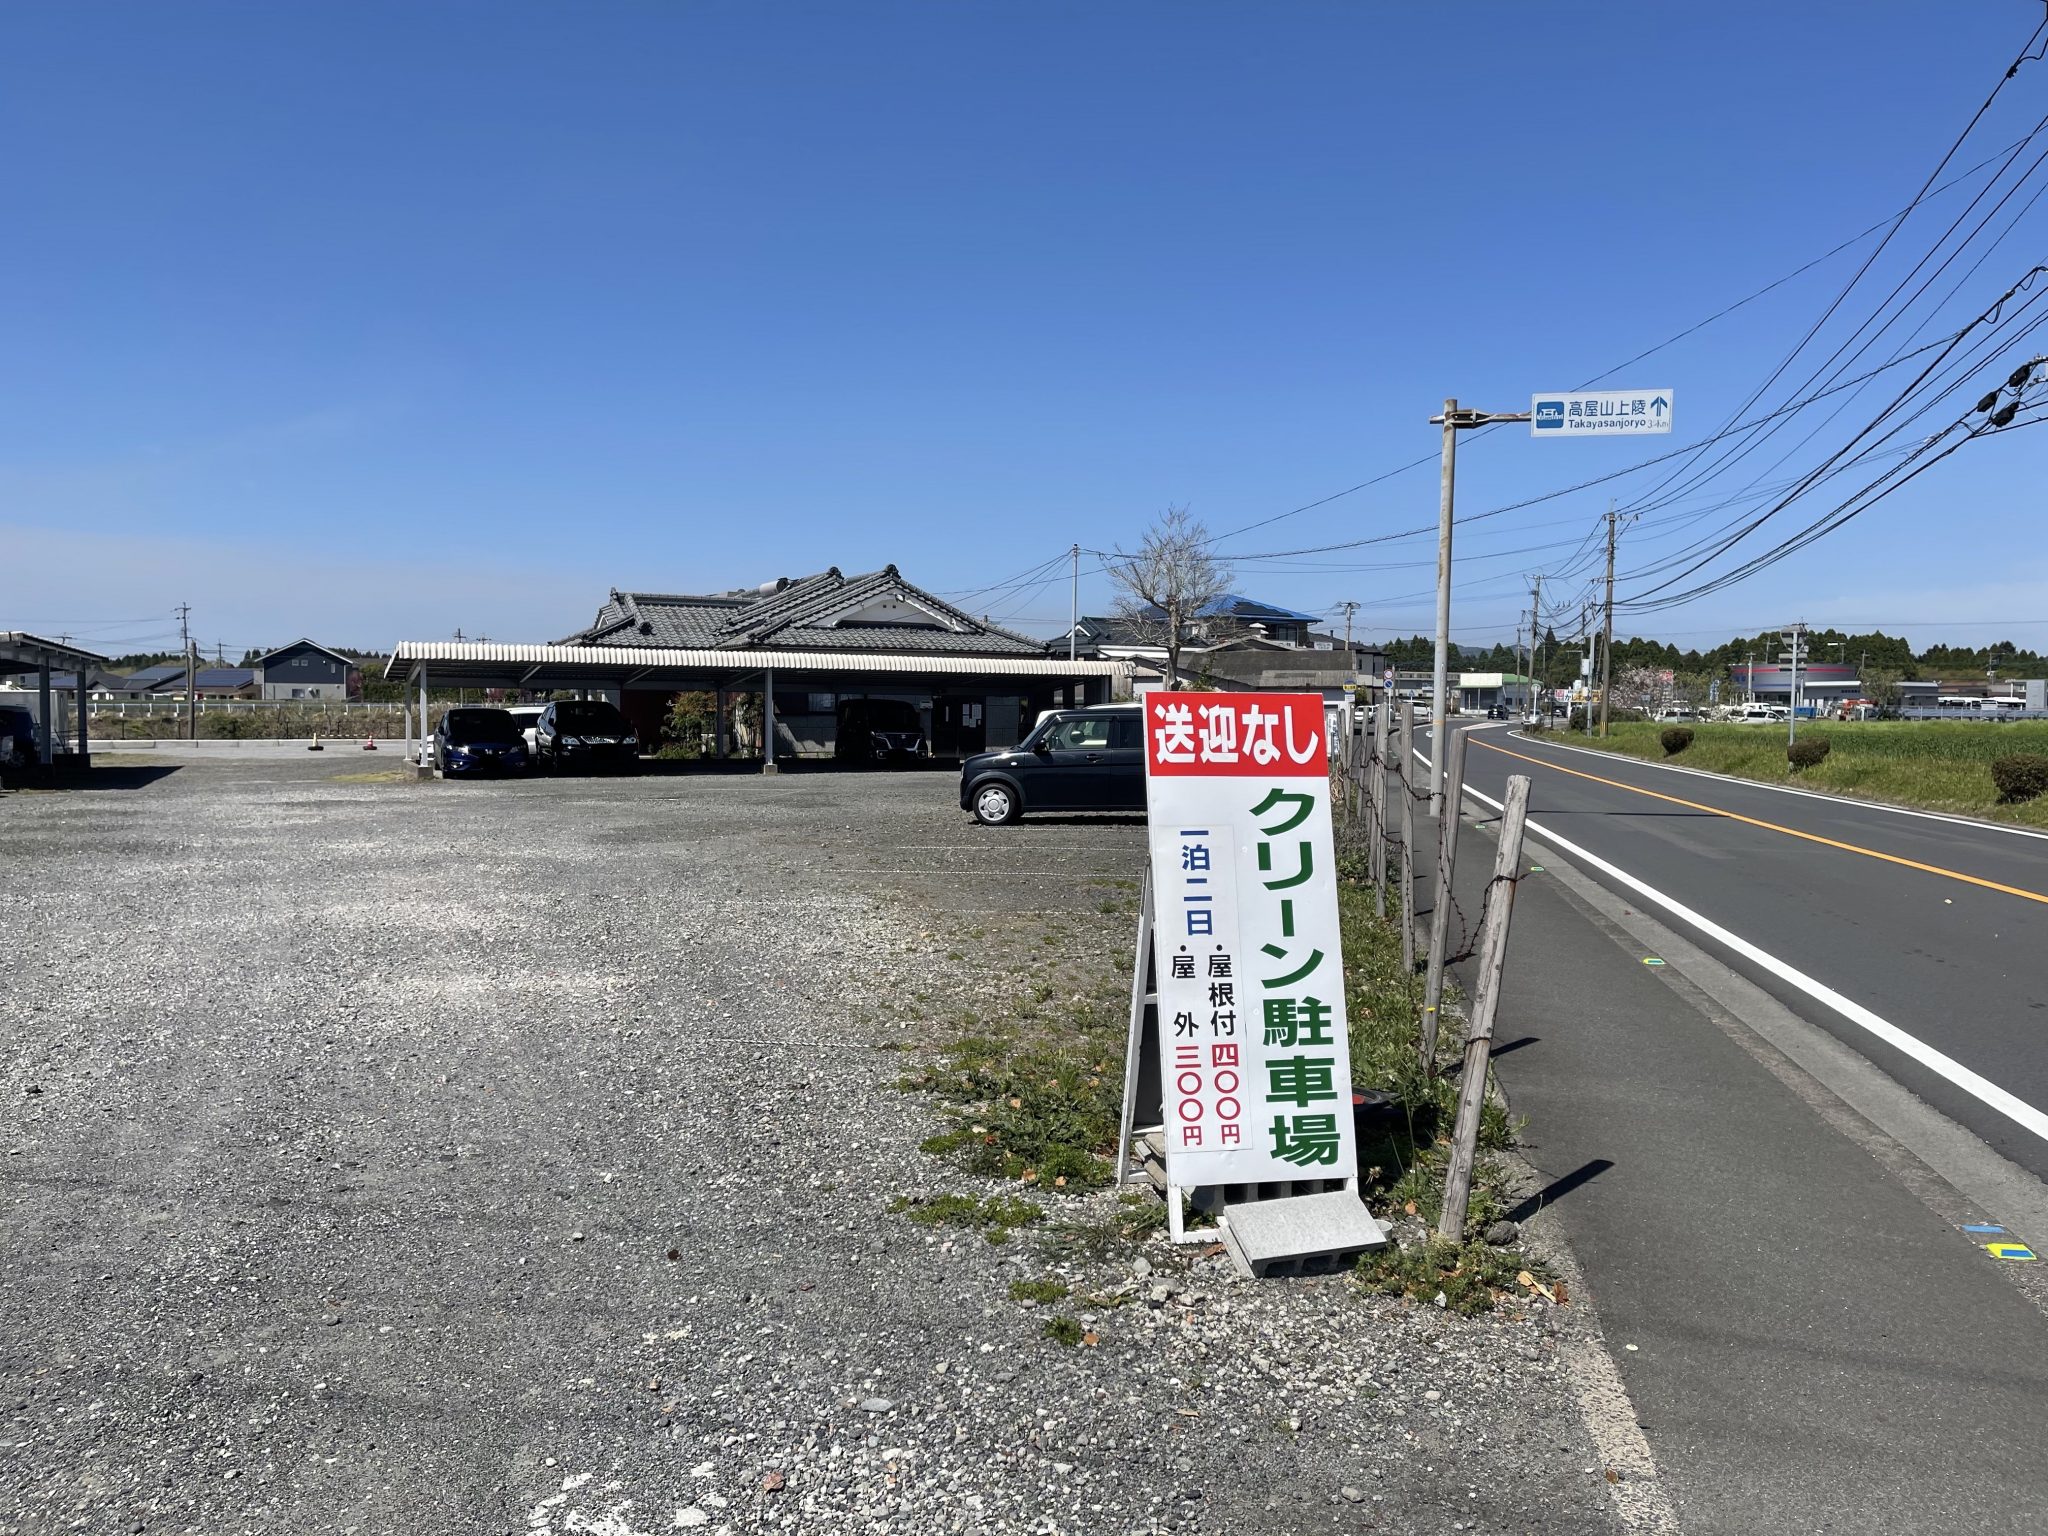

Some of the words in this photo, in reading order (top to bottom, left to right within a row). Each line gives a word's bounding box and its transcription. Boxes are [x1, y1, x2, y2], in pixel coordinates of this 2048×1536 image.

[1568, 400, 1646, 417] 高屋山上陵
[1568, 419, 1646, 429] Takayasanjoryo
[1154, 703, 1319, 766] 送迎なし
[1180, 830, 1213, 936] 一泊二日
[1249, 788, 1340, 1167] クリーン駐車場
